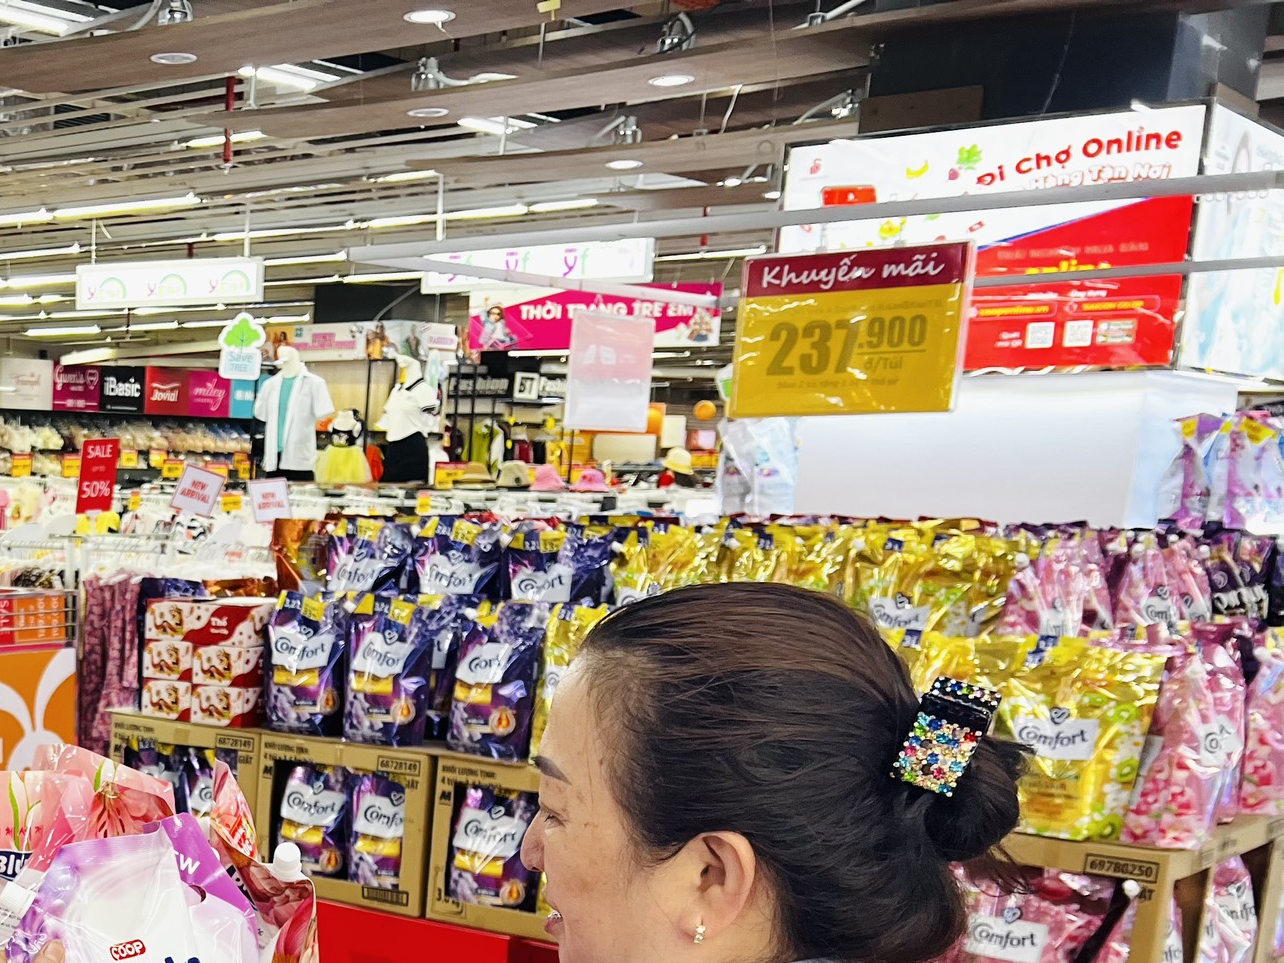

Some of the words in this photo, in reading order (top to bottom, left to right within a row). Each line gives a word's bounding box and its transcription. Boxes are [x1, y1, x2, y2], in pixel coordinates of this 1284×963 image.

[1015, 145, 1071, 173] Chợ
[1082, 126, 1183, 159] Online
[761, 254, 876, 290] Khuyến
[882, 252, 946, 281] mãi
[519, 299, 563, 321] THỜI
[103, 376, 142, 398] iBasic
[86, 444, 114, 459] SALE
[81, 479, 111, 499] 50%
[217, 736, 253, 750] 68728149
[1018, 725, 1089, 748] Comfort
[379, 758, 419, 774] 68728149
[970, 922, 1038, 950] Comfort
[111, 940, 145, 960] COOP
